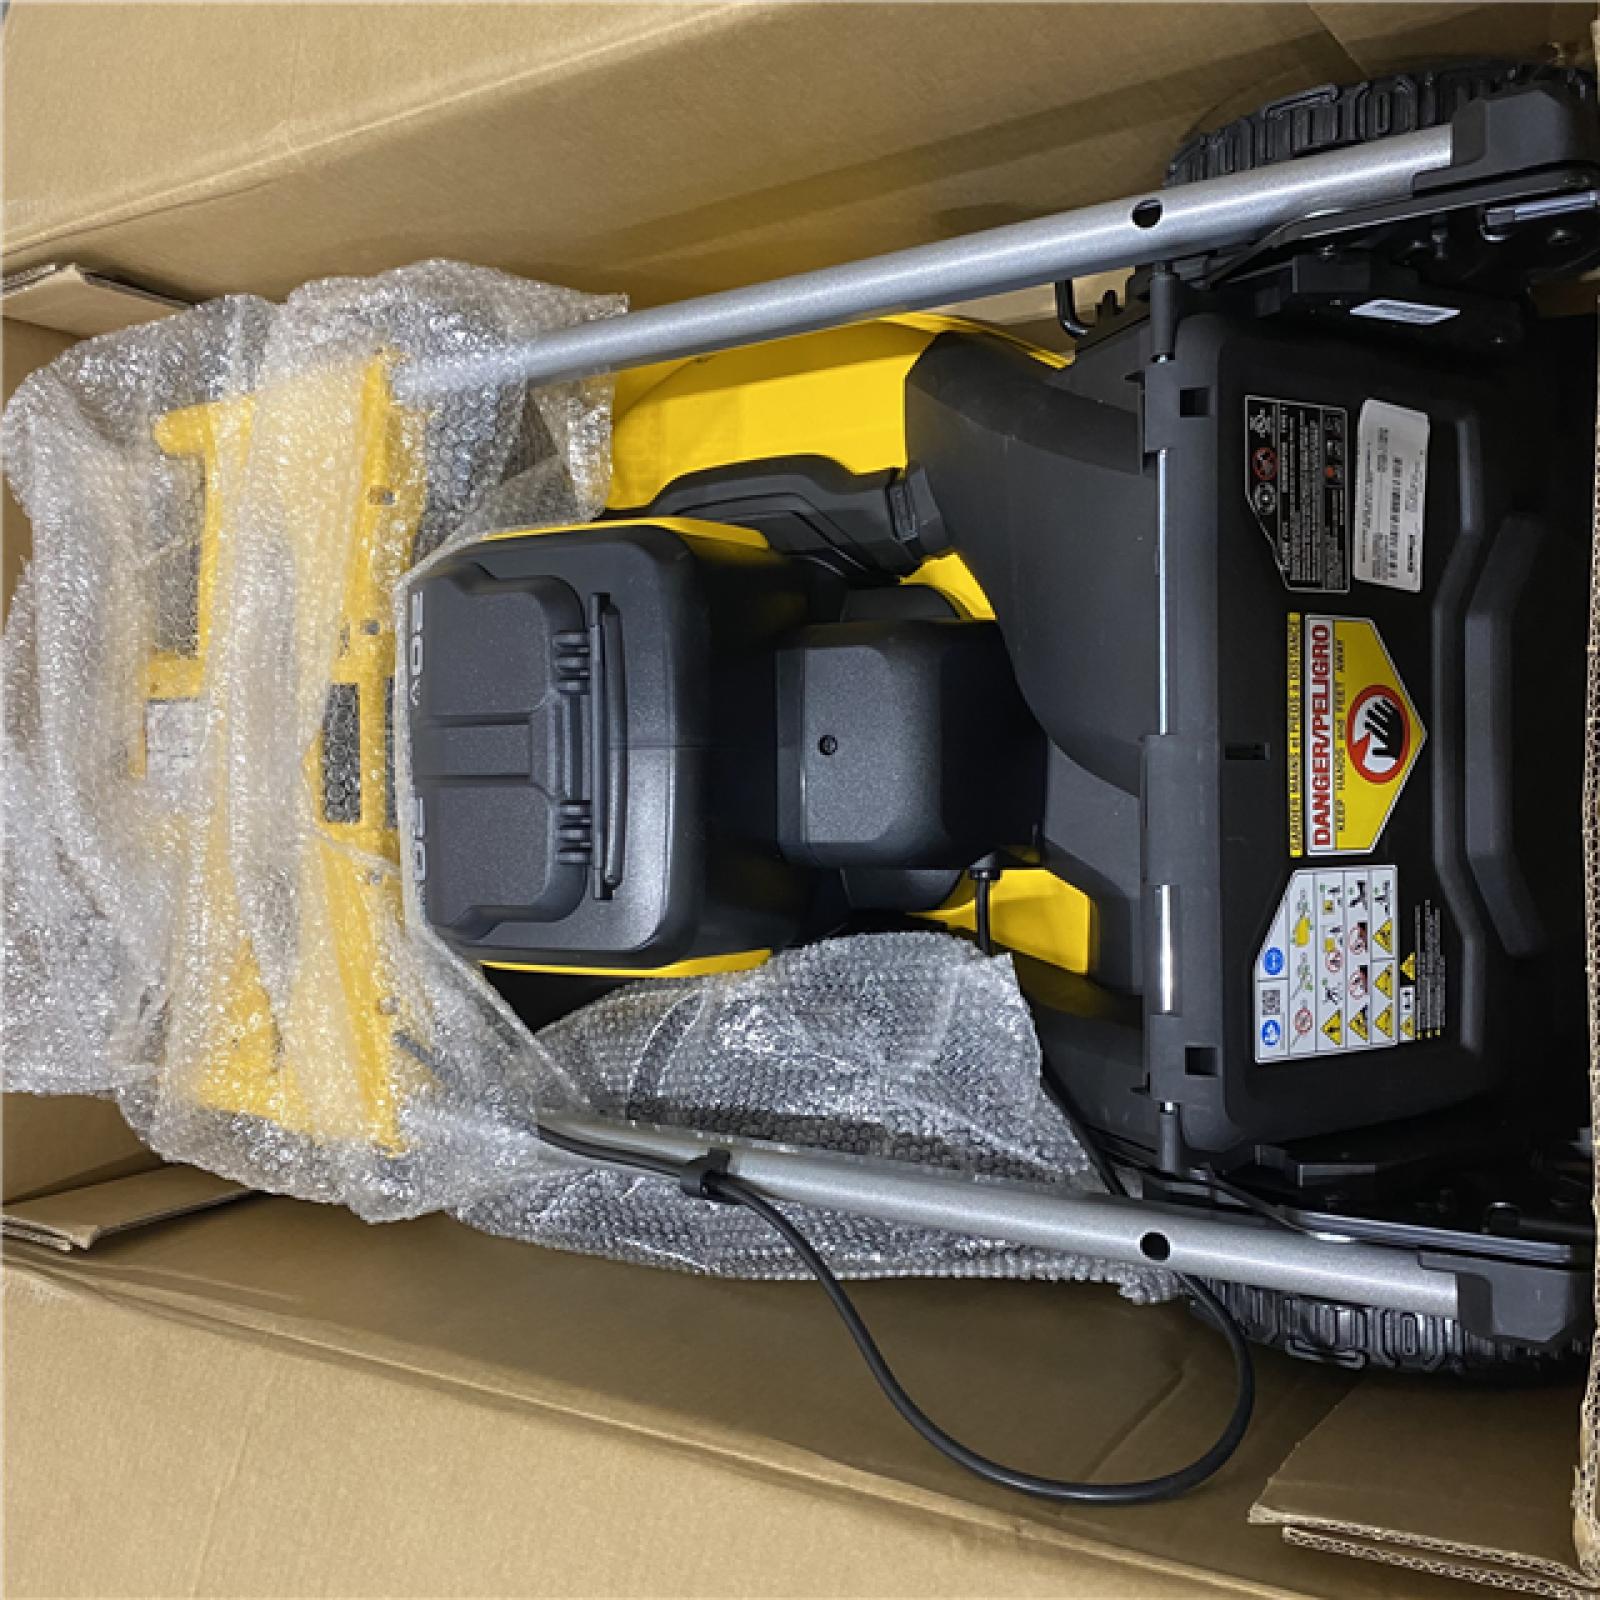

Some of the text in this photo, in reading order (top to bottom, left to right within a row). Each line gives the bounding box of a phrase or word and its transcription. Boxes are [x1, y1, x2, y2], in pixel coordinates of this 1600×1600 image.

[1335, 639, 1345, 673] AWAY
[1335, 682, 1345, 713] FEET
[1312, 624, 1330, 846] DANGER/PELIGRO
[1335, 748, 1345, 791] HANDS
[1335, 799, 1345, 832] KEEP
